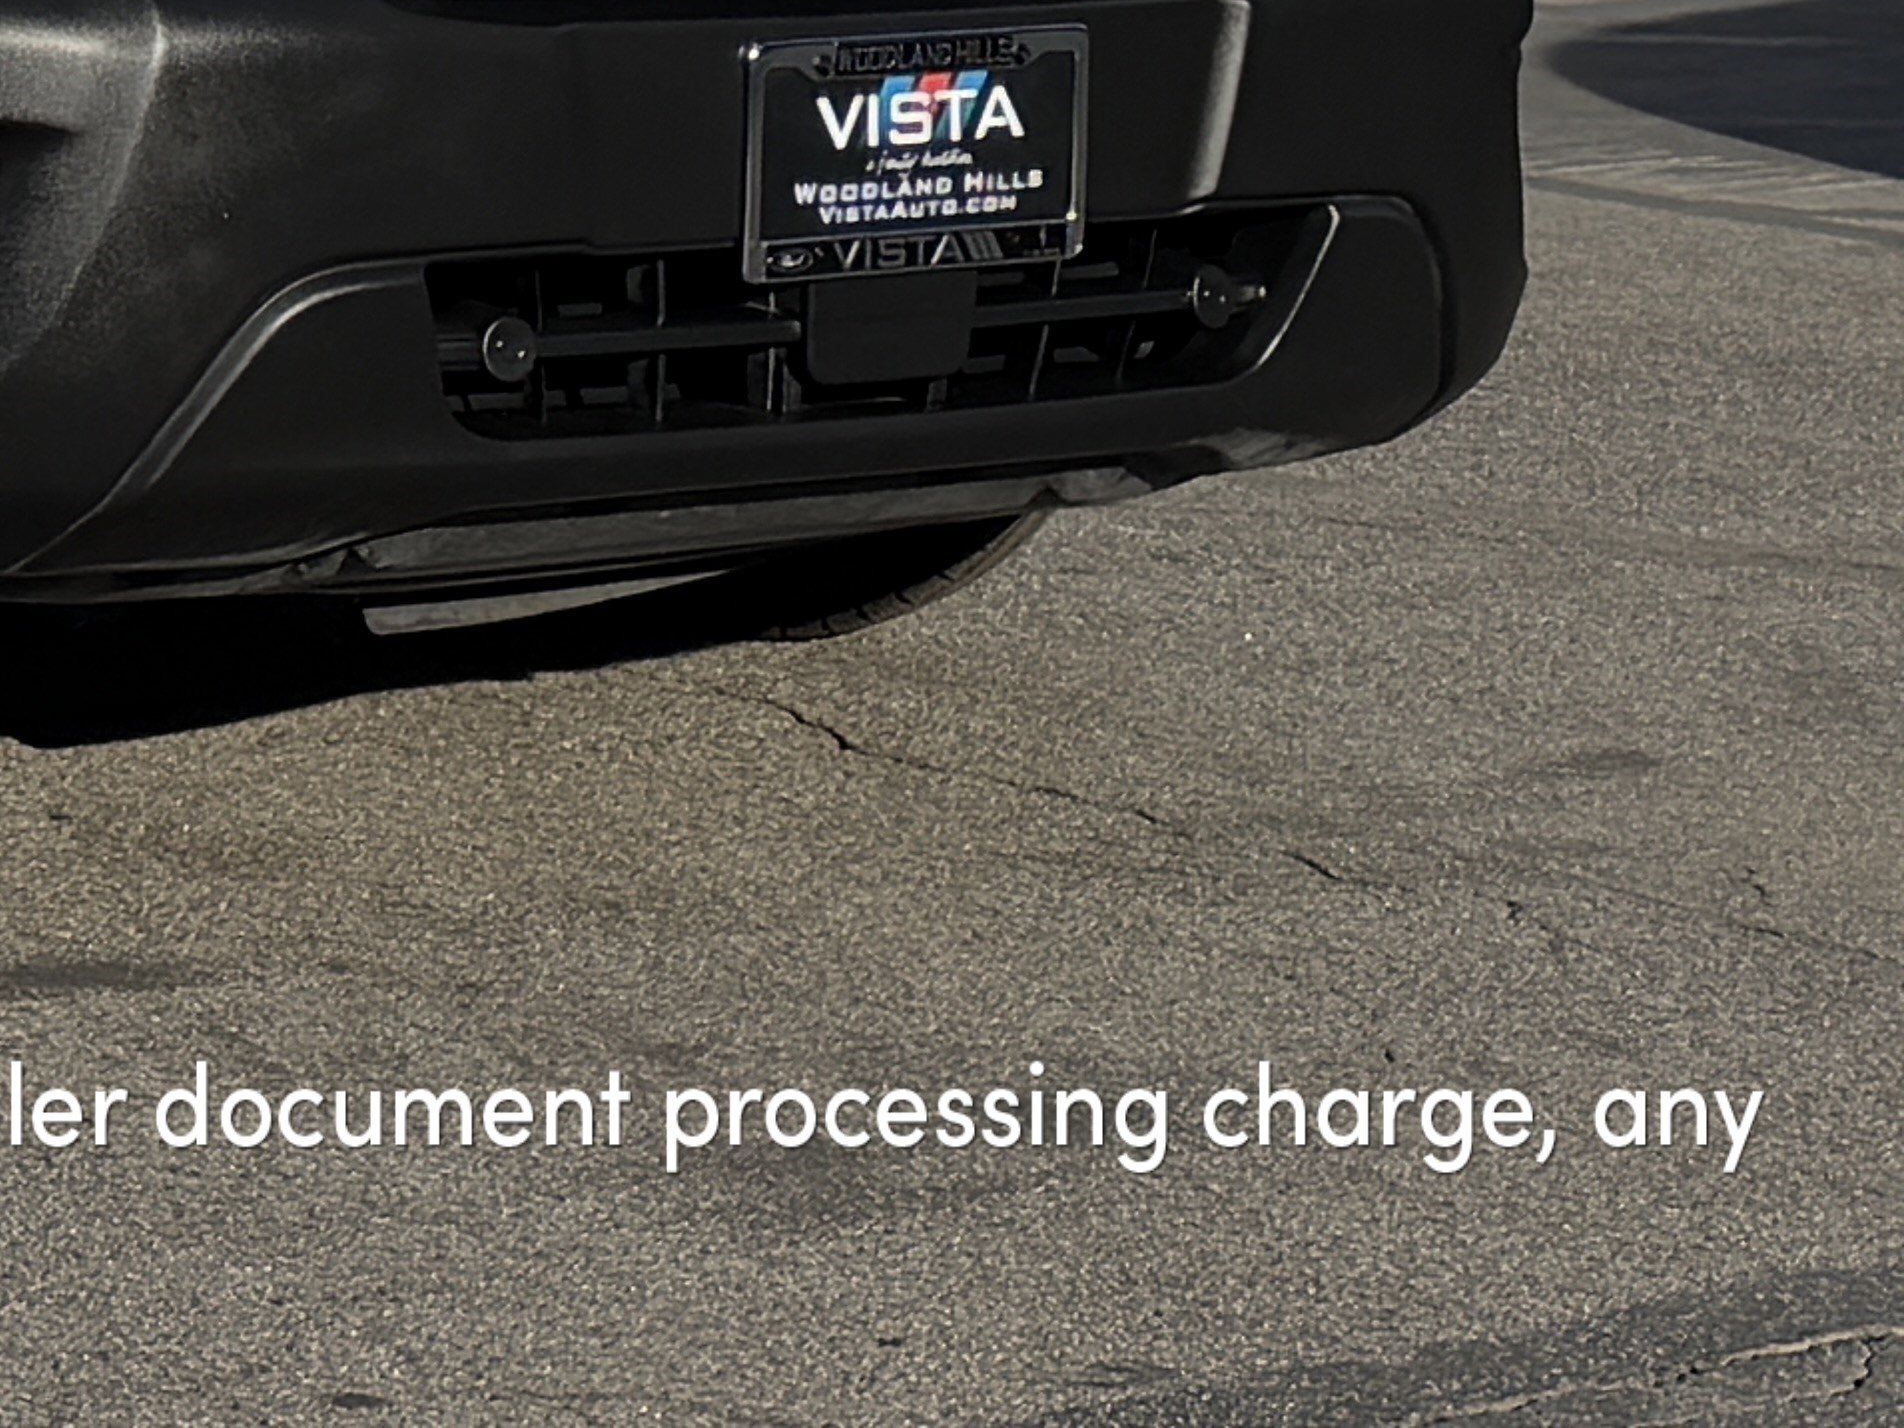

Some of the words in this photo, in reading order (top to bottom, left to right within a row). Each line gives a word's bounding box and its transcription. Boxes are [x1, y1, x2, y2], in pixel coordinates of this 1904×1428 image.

[815, 85, 1026, 151] VISTA
[794, 175, 953, 205] WOODLAND
[964, 168, 1044, 193] HILLS
[835, 231, 965, 270] VISTA
